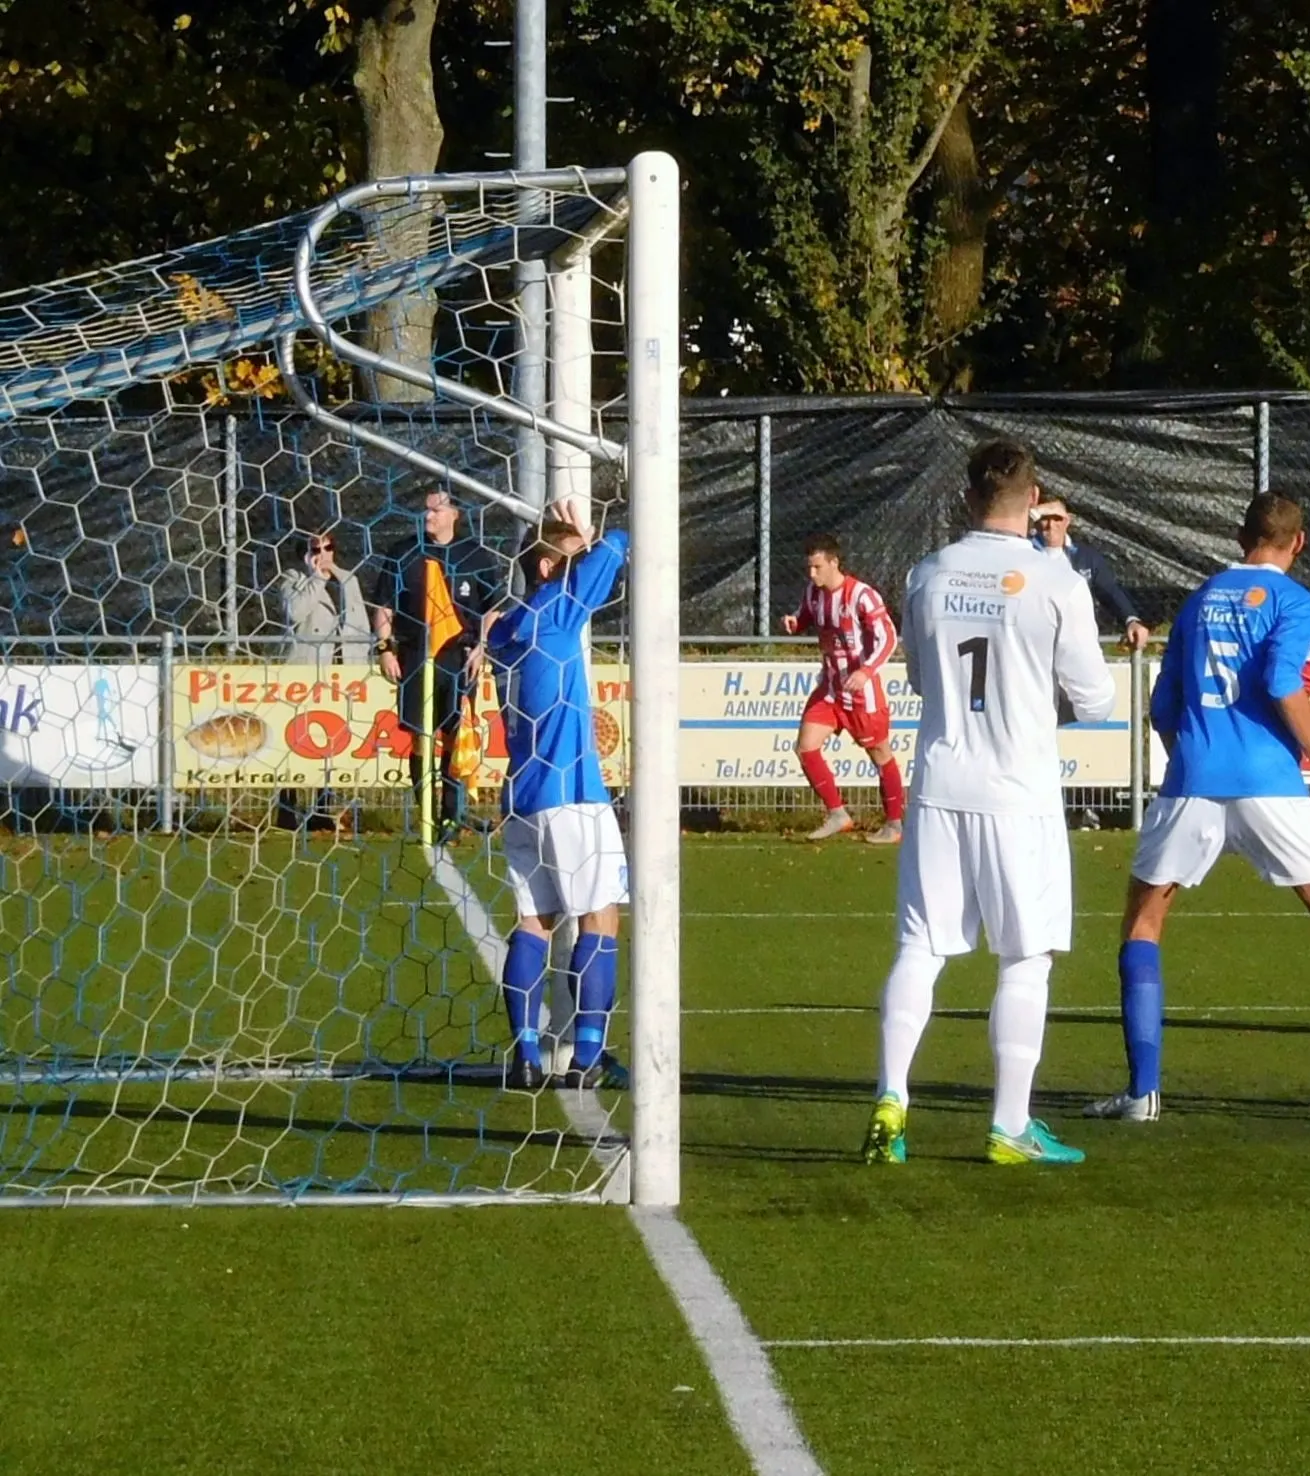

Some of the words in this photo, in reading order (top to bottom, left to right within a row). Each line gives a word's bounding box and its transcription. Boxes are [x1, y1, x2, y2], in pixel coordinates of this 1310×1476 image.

[189, 670, 367, 704] Pizzeria
[724, 672, 749, 696] H.
[957, 637, 989, 712] 1
[1201, 640, 1240, 709] 5
[187, 769, 305, 784] Kerkrade
